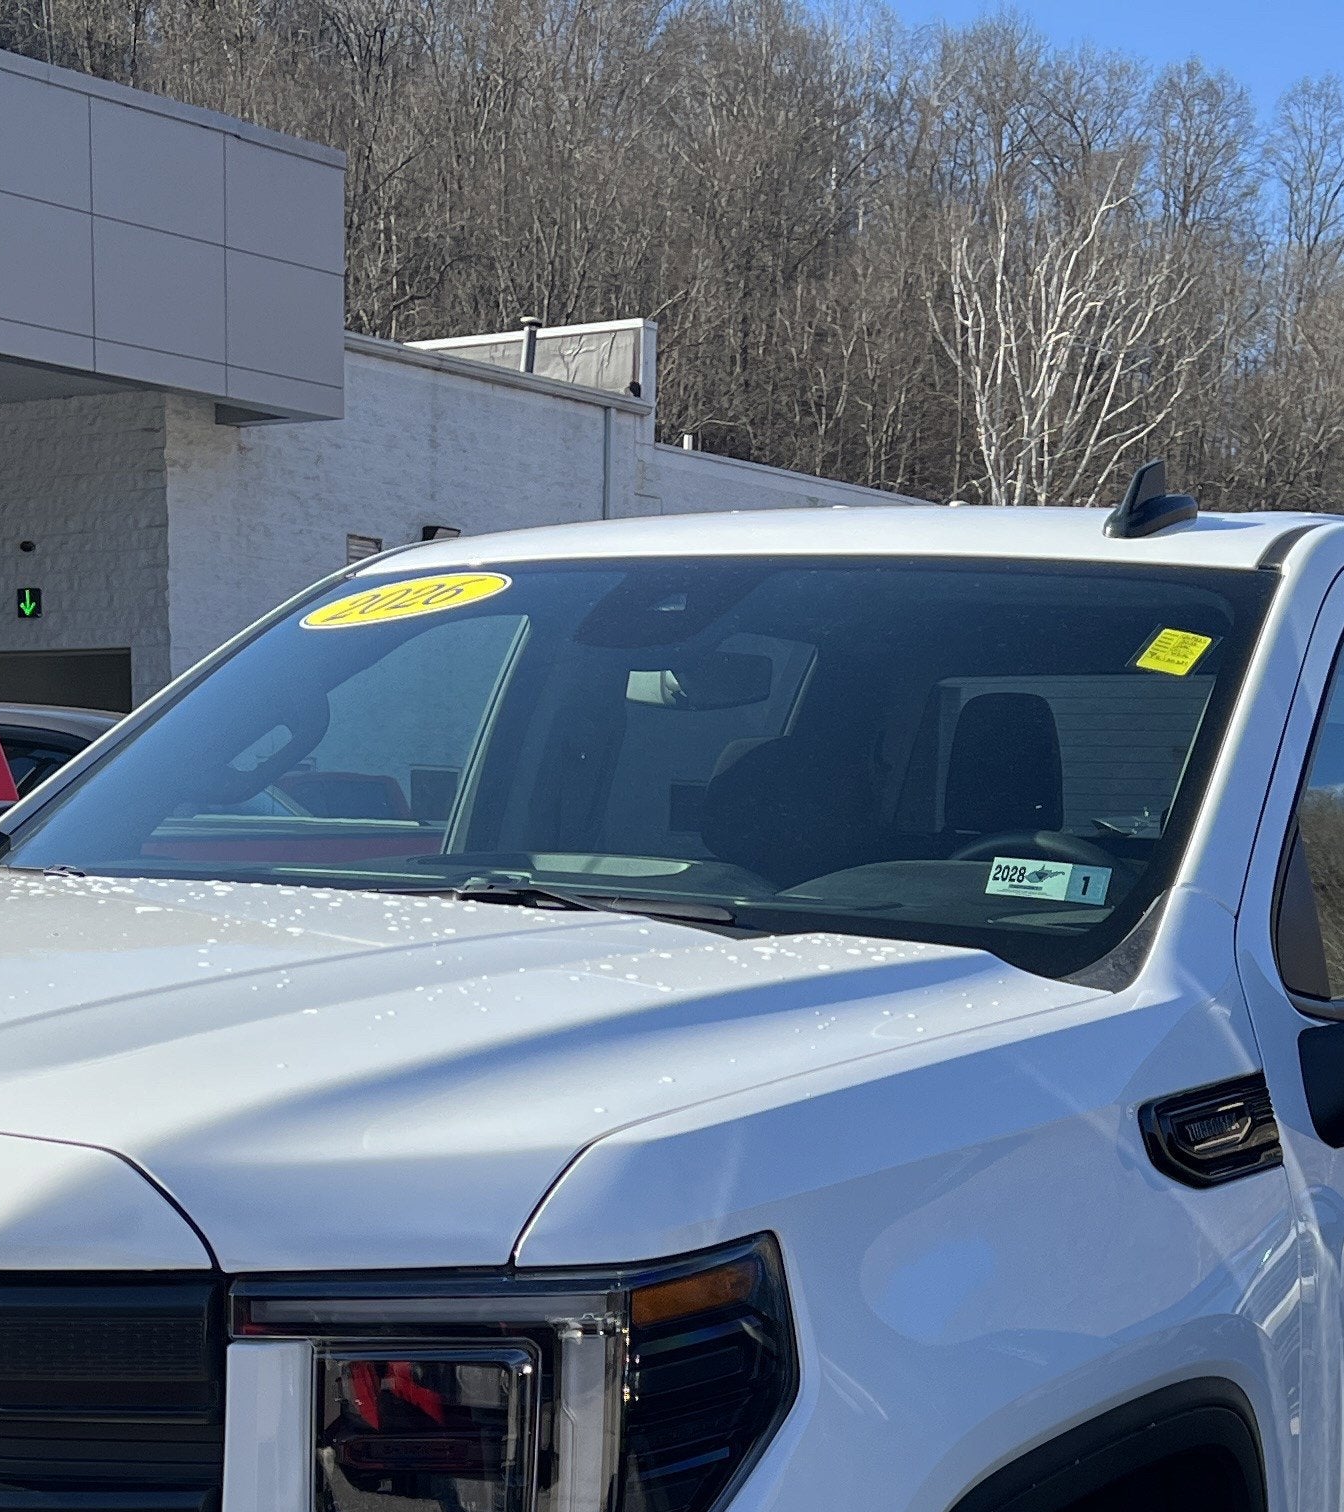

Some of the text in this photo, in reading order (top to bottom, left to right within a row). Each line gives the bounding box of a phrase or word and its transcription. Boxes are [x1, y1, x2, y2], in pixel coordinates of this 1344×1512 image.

[321, 577, 487, 623] 2026
[992, 864, 1027, 883] 2028
[1081, 875, 1091, 896] 1
